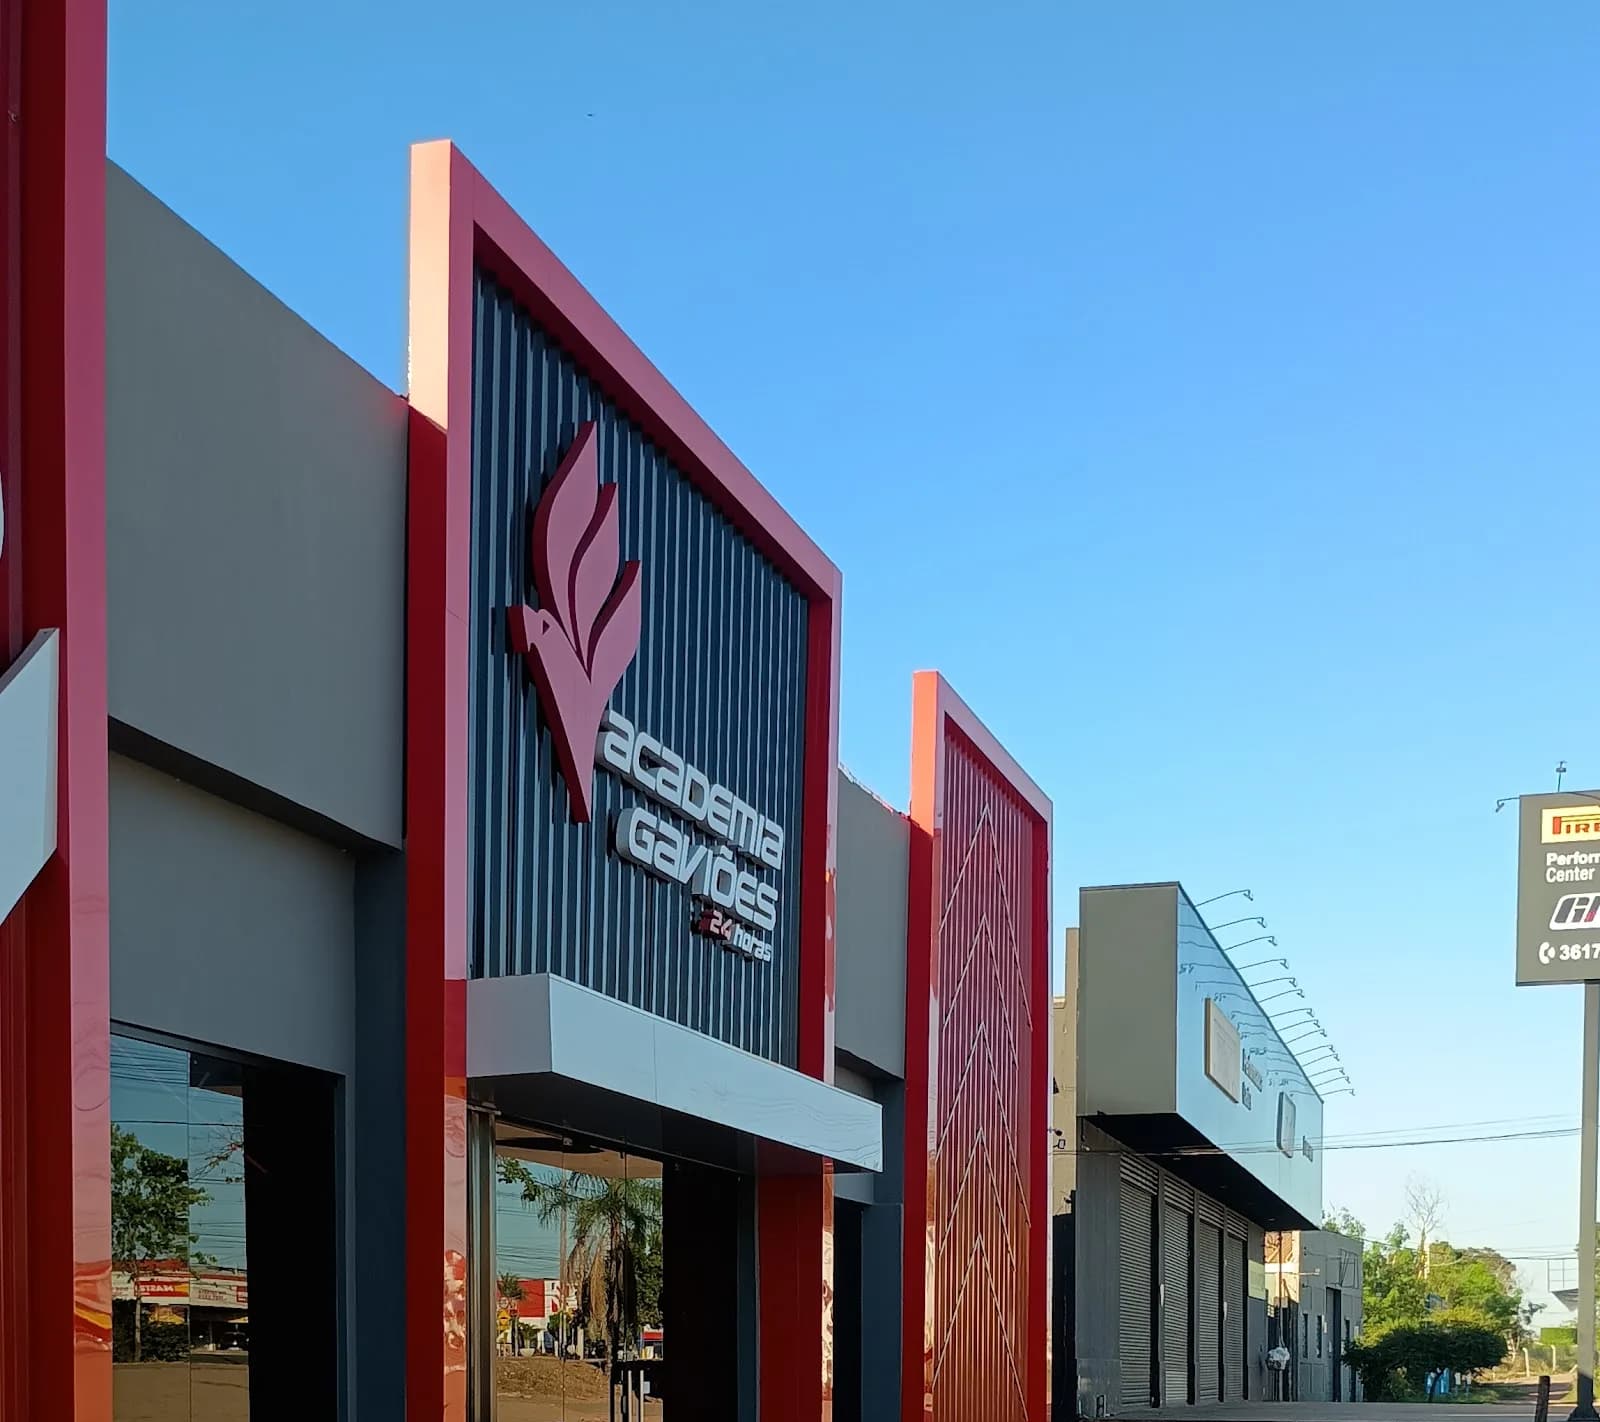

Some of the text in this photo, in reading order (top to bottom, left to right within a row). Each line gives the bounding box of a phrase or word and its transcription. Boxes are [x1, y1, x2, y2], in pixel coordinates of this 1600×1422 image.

[1546, 866, 1596, 883] Center
[709, 910, 772, 962] 24 horas
[1559, 943, 1600, 961] 3617
